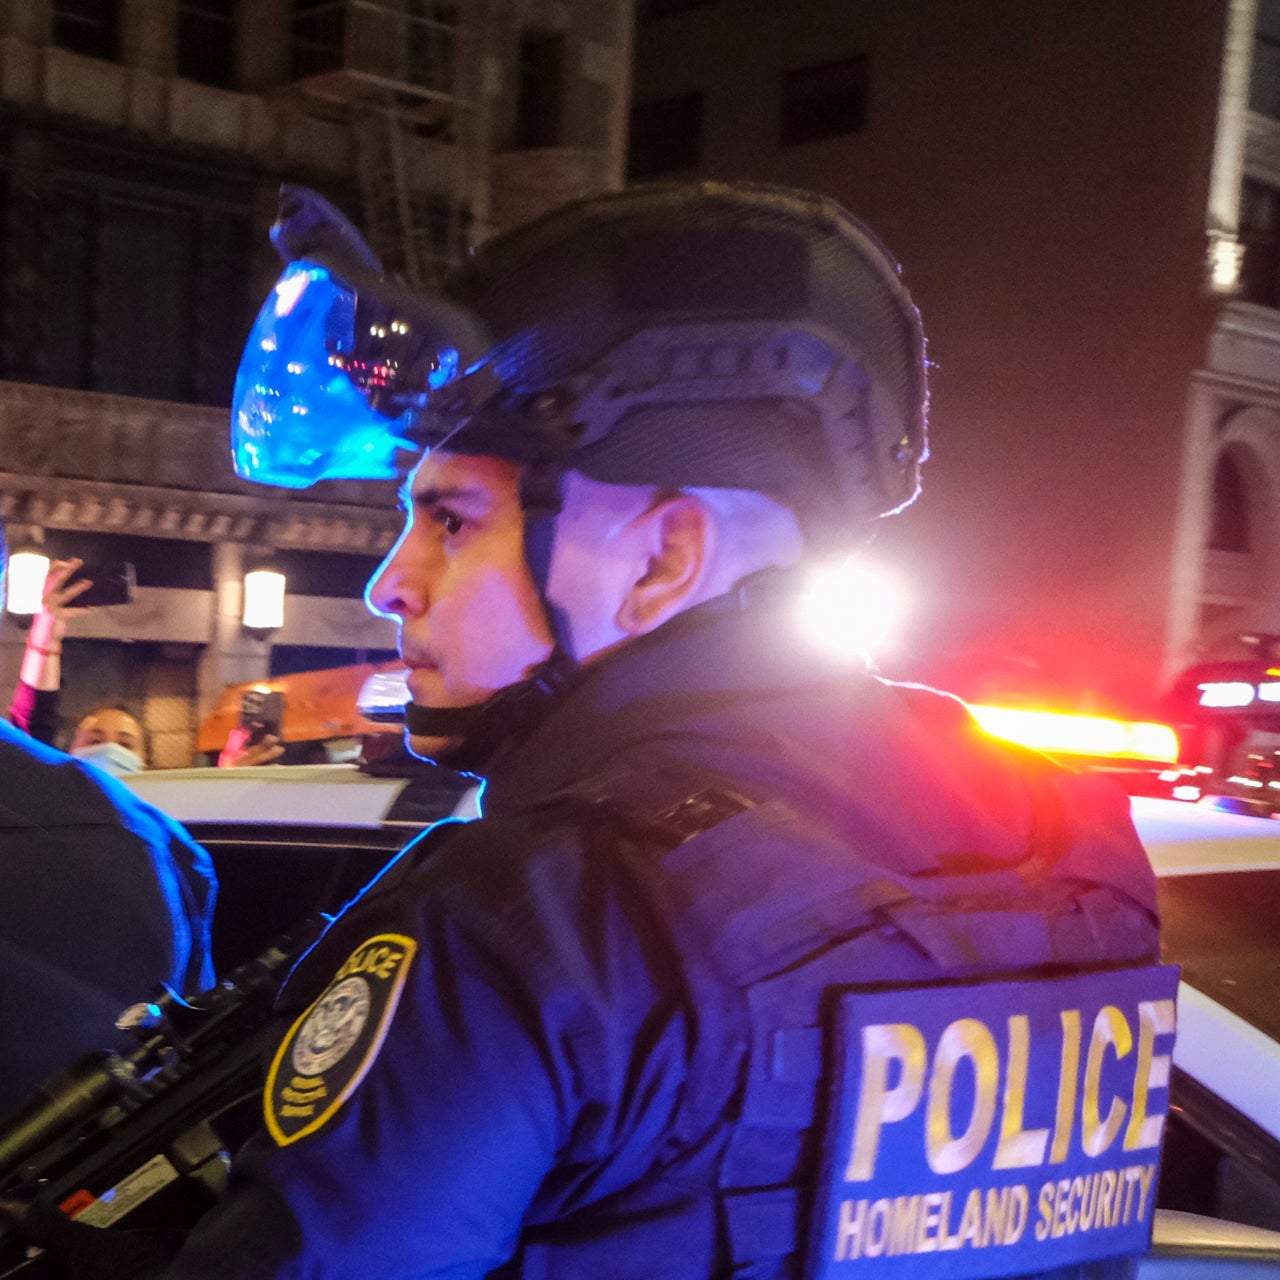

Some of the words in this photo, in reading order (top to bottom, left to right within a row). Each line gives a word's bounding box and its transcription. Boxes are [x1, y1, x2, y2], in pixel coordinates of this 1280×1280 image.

[844, 999, 1176, 1182] POLICE
[835, 1184, 1029, 1262] HOMELAND
[1035, 1164, 1156, 1241] SECURITY
